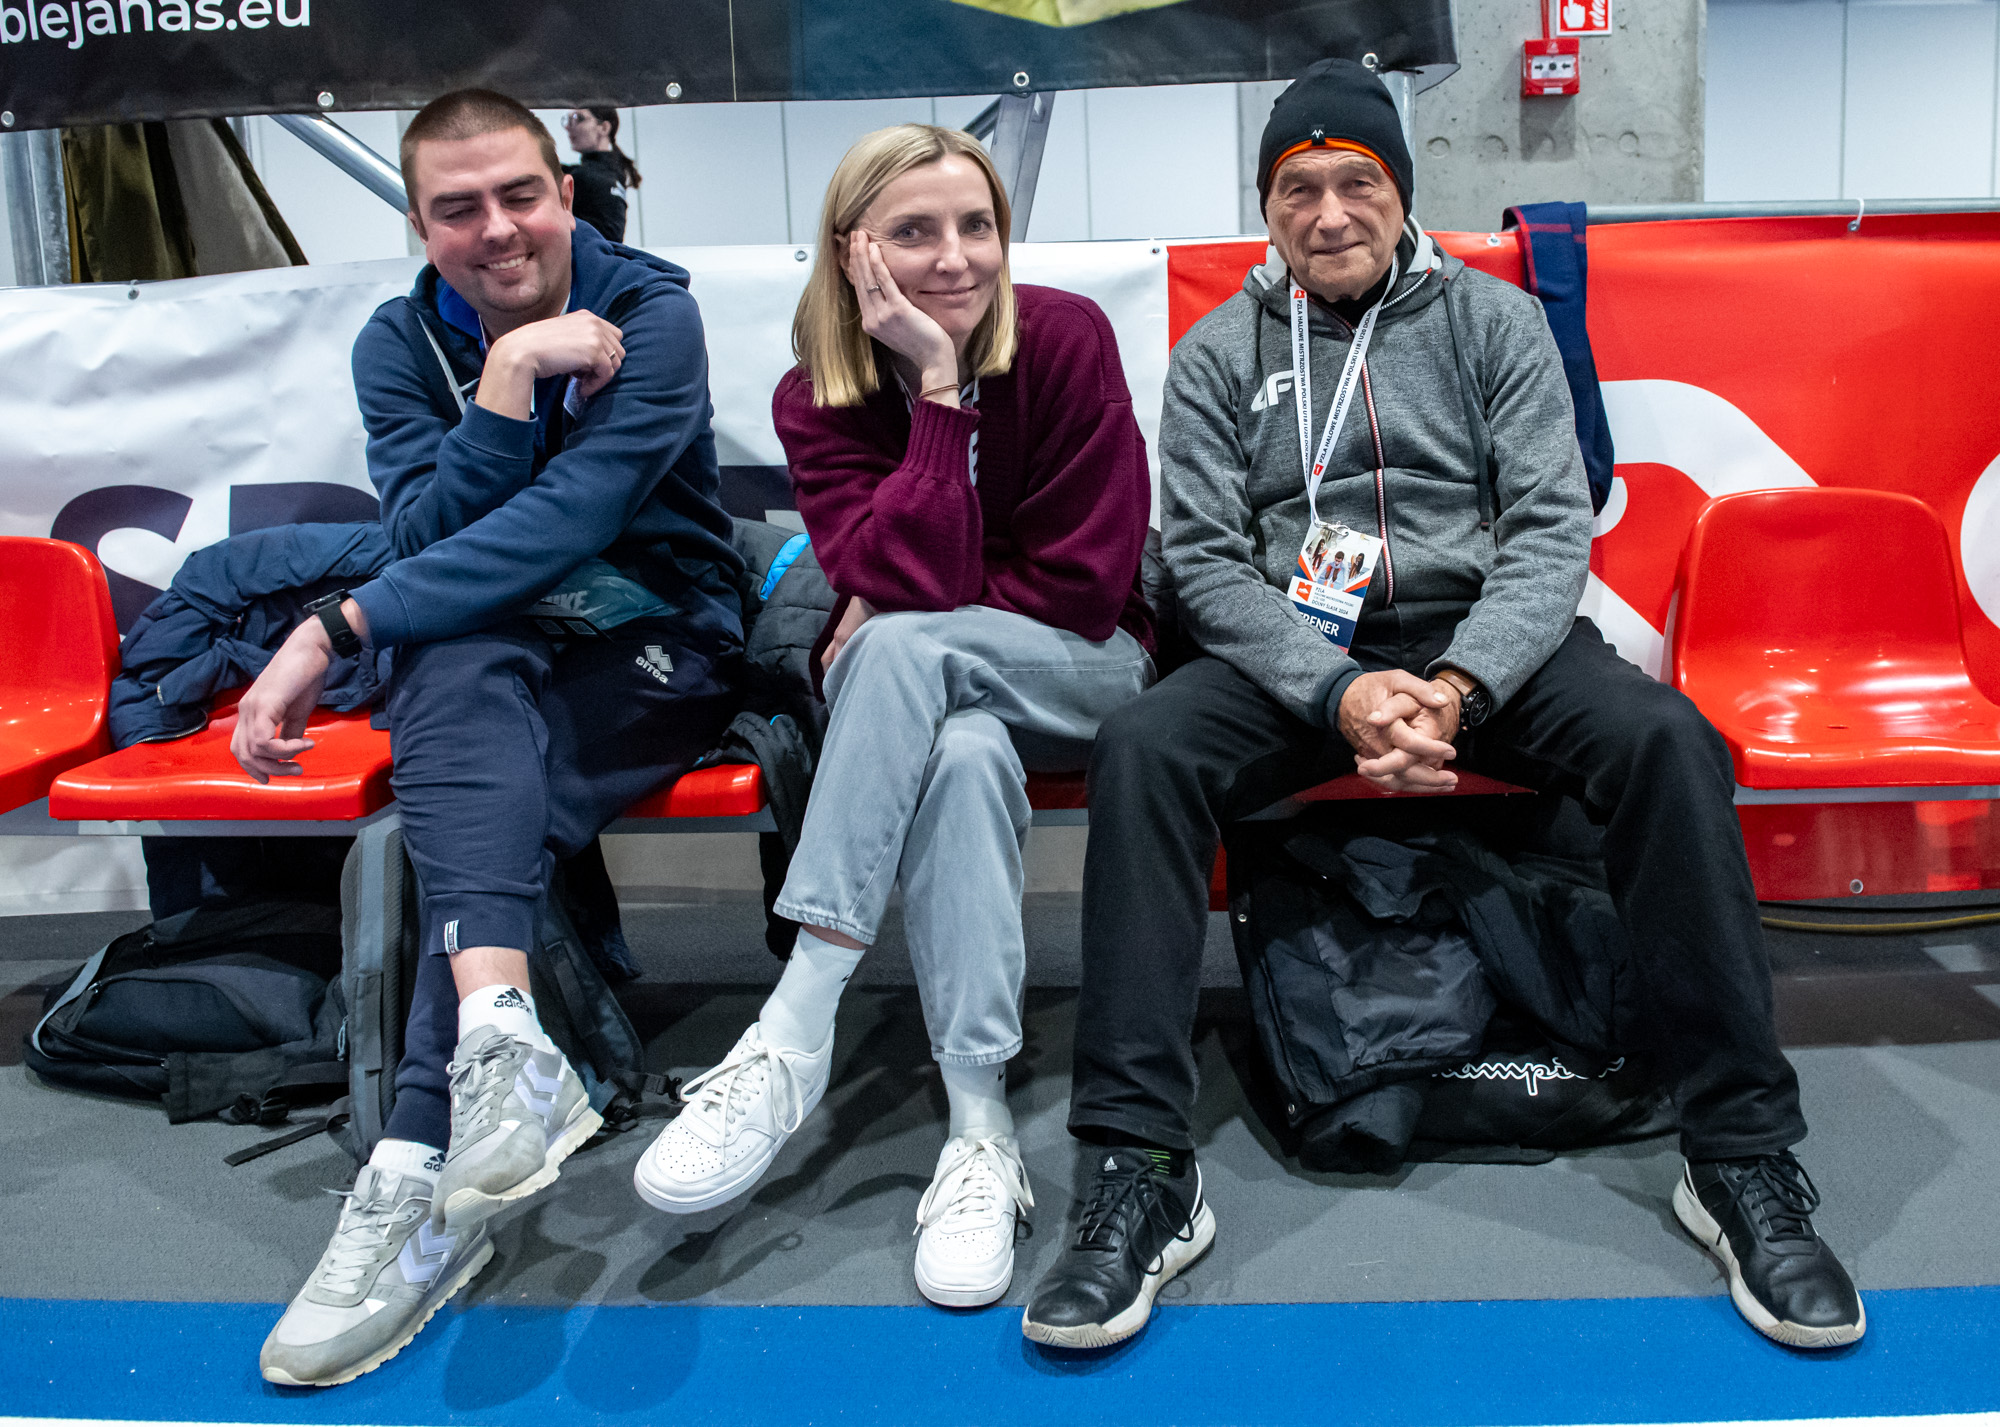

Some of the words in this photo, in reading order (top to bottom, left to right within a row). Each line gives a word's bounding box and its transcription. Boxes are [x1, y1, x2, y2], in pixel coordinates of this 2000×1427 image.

[1319, 448, 1328, 464] PZLA
[1325, 420, 1338, 448] HALOWE
[1333, 377, 1351, 421] MISTRZOSTWA
[1347, 355, 1358, 377] POLSKI
[1299, 612, 1340, 637] RENER
